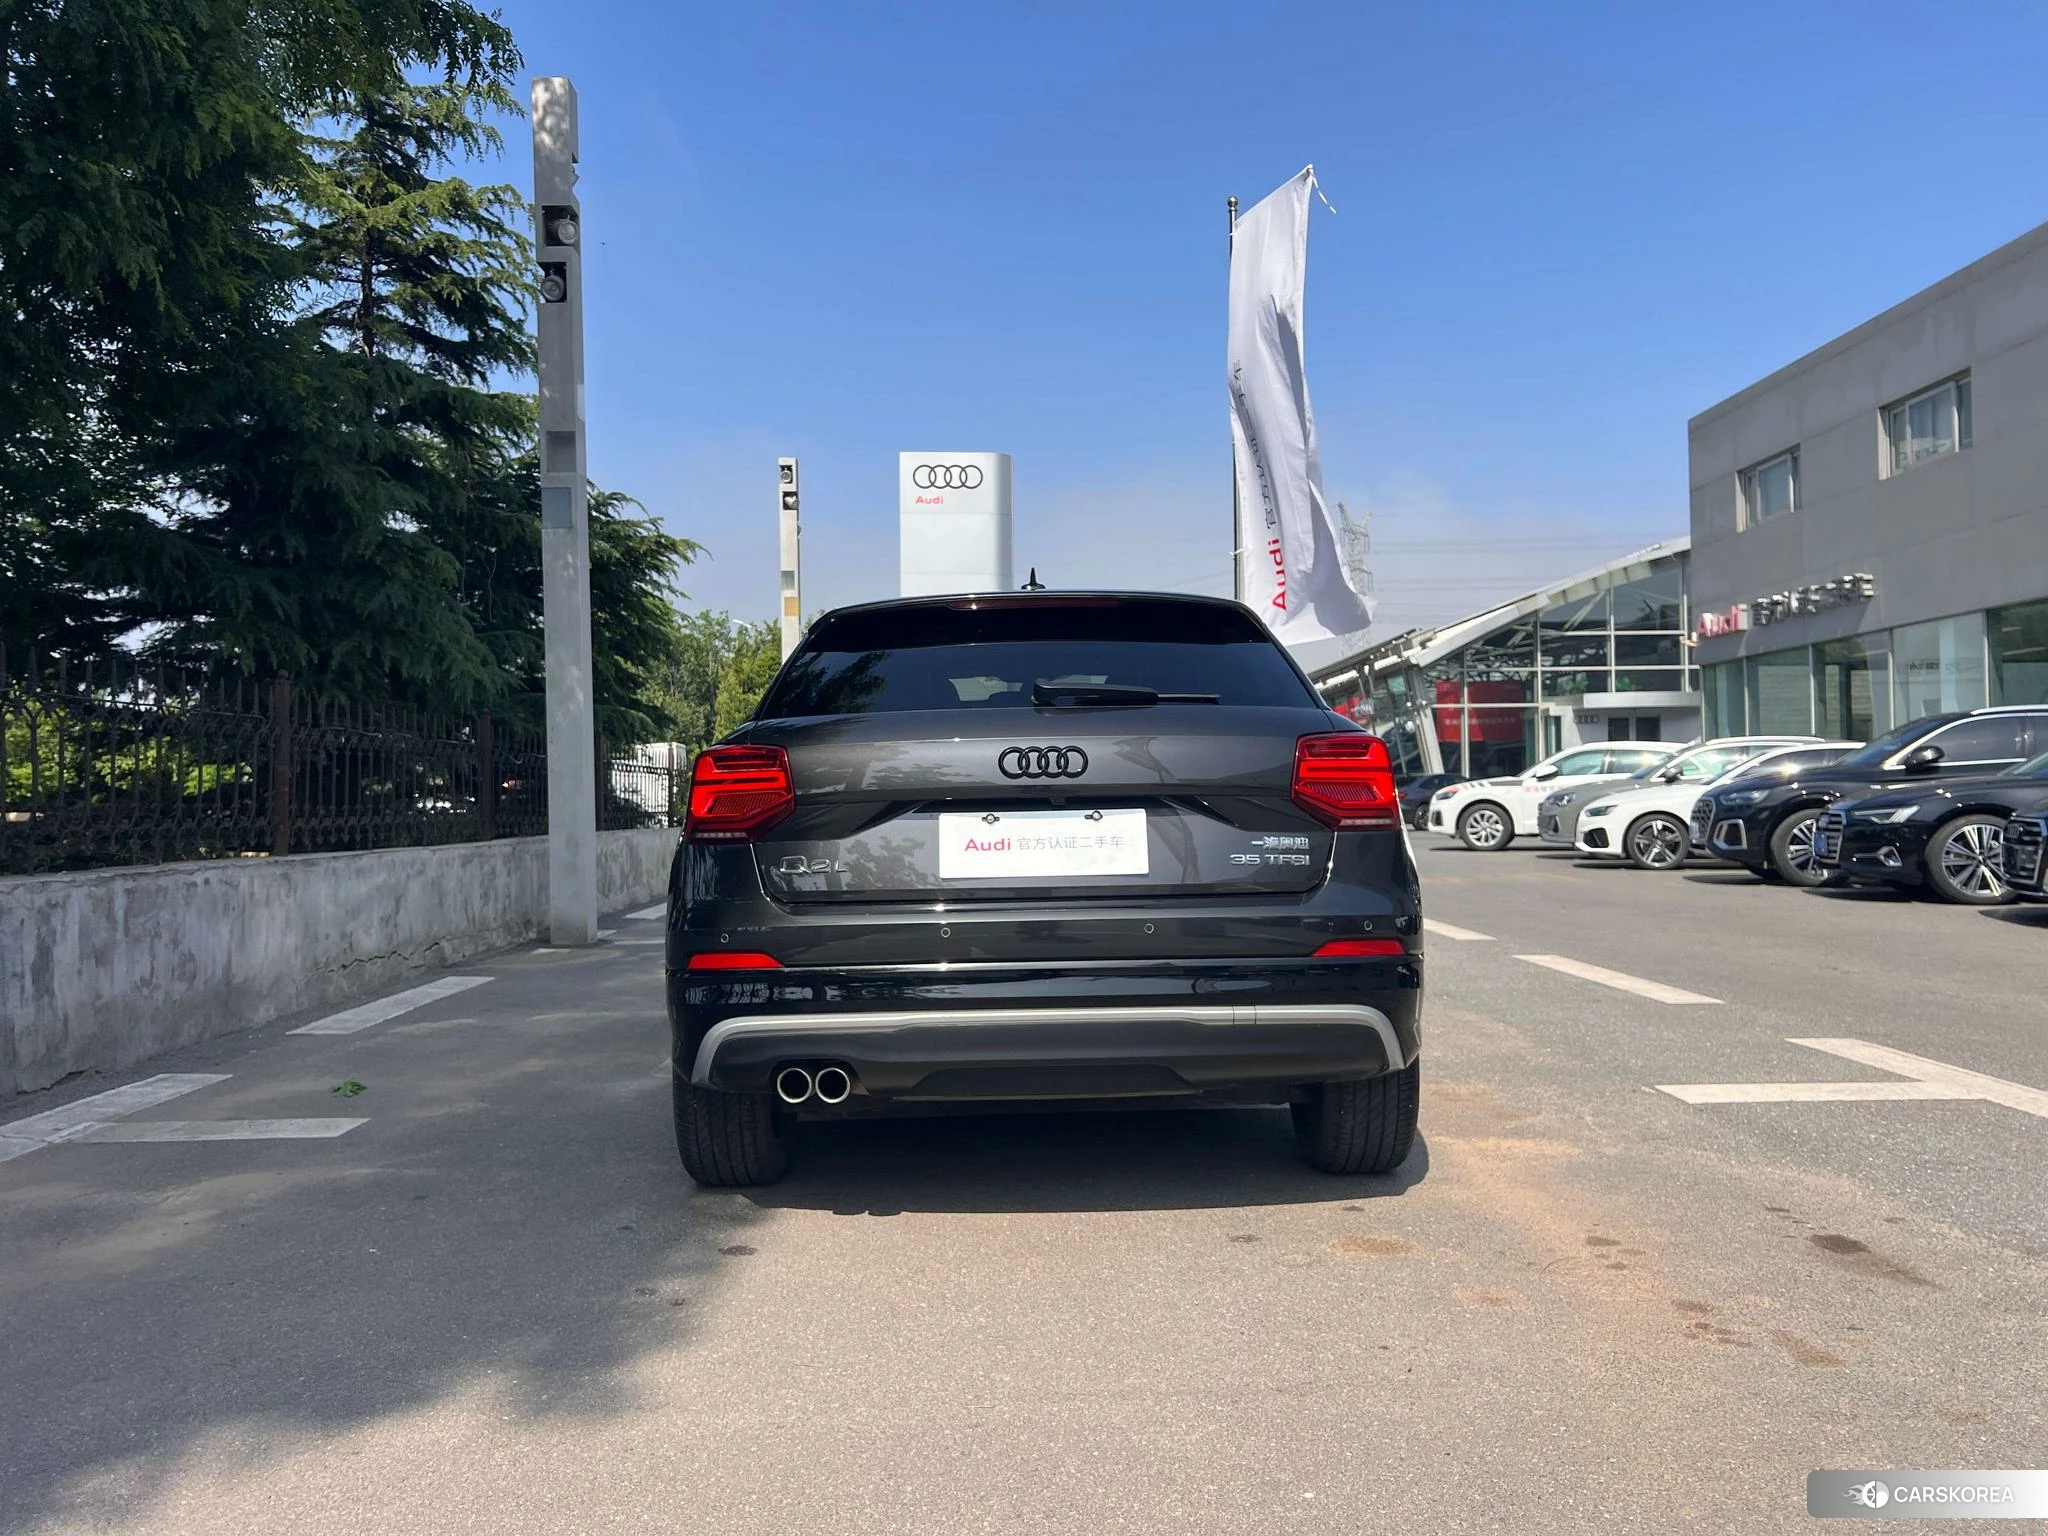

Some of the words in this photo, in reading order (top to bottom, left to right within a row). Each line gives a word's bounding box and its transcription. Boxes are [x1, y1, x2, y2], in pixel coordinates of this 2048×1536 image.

[915, 495, 944, 505] Audi
[1268, 538, 1287, 611] Audi
[964, 837, 1012, 852] Audi
[1018, 835, 1125, 851] 官方认证二手车
[780, 855, 849, 874] Q2L
[1229, 854, 1261, 865] 35
[1265, 854, 1310, 866] TFSI
